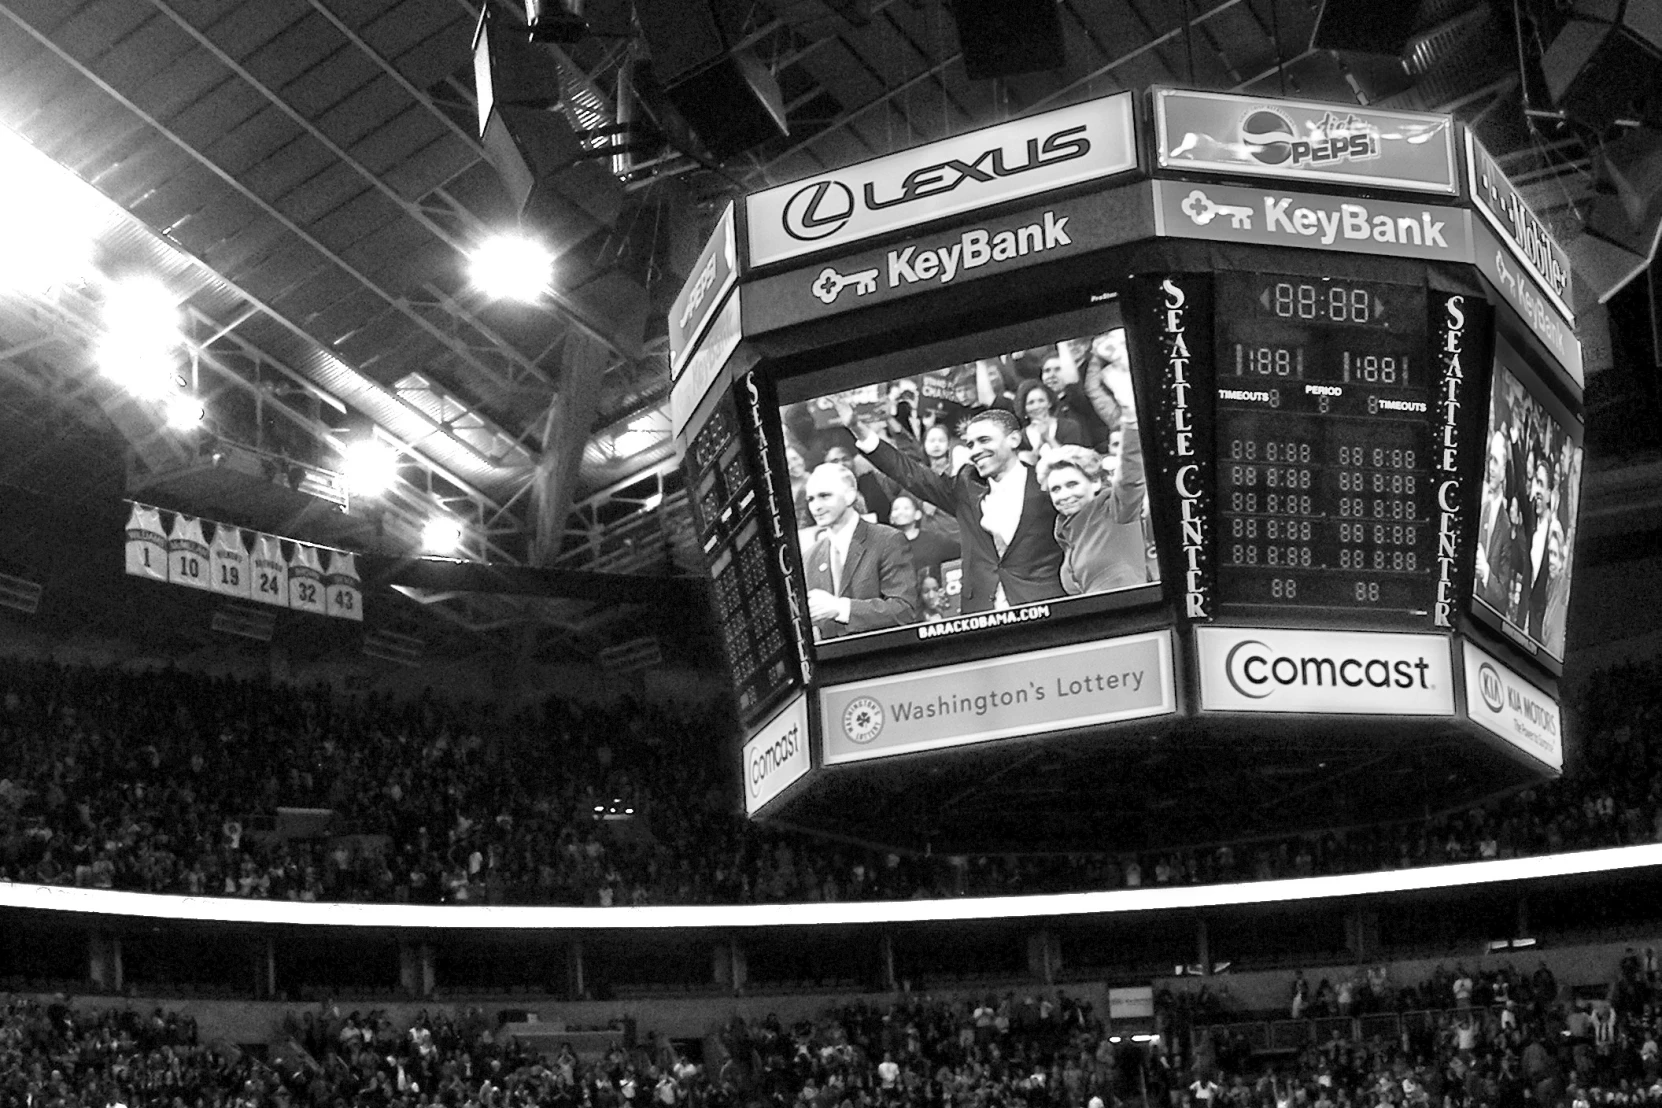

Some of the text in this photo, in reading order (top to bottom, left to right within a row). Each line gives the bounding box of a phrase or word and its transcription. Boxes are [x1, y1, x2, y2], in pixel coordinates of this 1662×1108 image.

[1291, 133, 1377, 164] PEPSI
[864, 124, 1092, 211] LEXUS
[1263, 197, 1448, 248] KeyBank
[887, 210, 1073, 288] KeyBank
[1516, 272, 1565, 356] KeyBank
[1218, 389, 1270, 402] TIMEOUTS
[1305, 384, 1343, 397] PERIOD
[1378, 399, 1428, 413] TIMEOUTS
[1162, 279, 1208, 619] SEATTLE CENTER
[1434, 295, 1466, 628] SEATTLE CENTER
[143, 547, 151, 568] 1
[180, 556, 199, 578] 10
[221, 564, 240, 586] 19
[260, 574, 279, 595] 24
[298, 583, 317, 604] 32
[335, 590, 354, 611] 43
[918, 605, 1051, 640] BARACKOBAMA.COM
[891, 667, 1146, 724] Washington's Lottery
[1483, 671, 1501, 703] KIA
